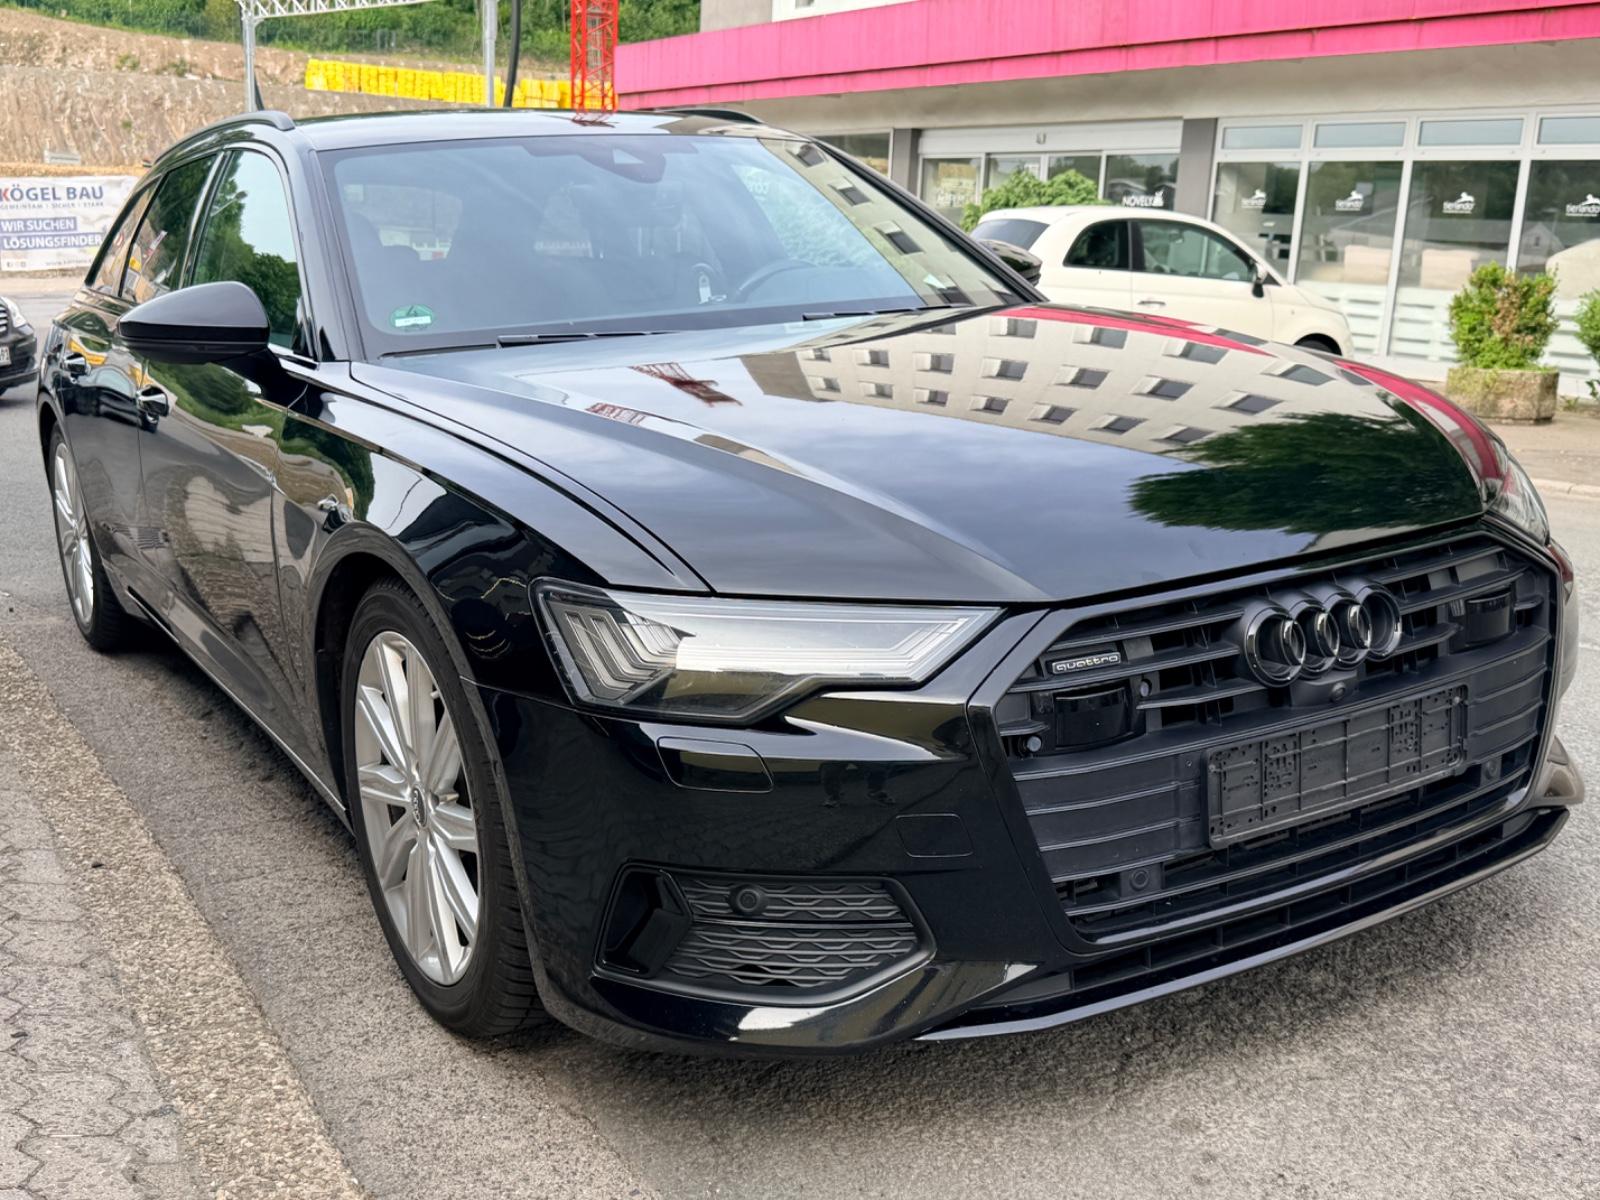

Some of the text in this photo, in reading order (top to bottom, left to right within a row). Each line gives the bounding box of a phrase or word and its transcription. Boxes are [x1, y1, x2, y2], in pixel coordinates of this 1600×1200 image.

[0, 184, 104, 202] KÖGEL BAU
[1, 219, 75, 232] WIR SUCHEN
[1056, 654, 1119, 671] quattro
